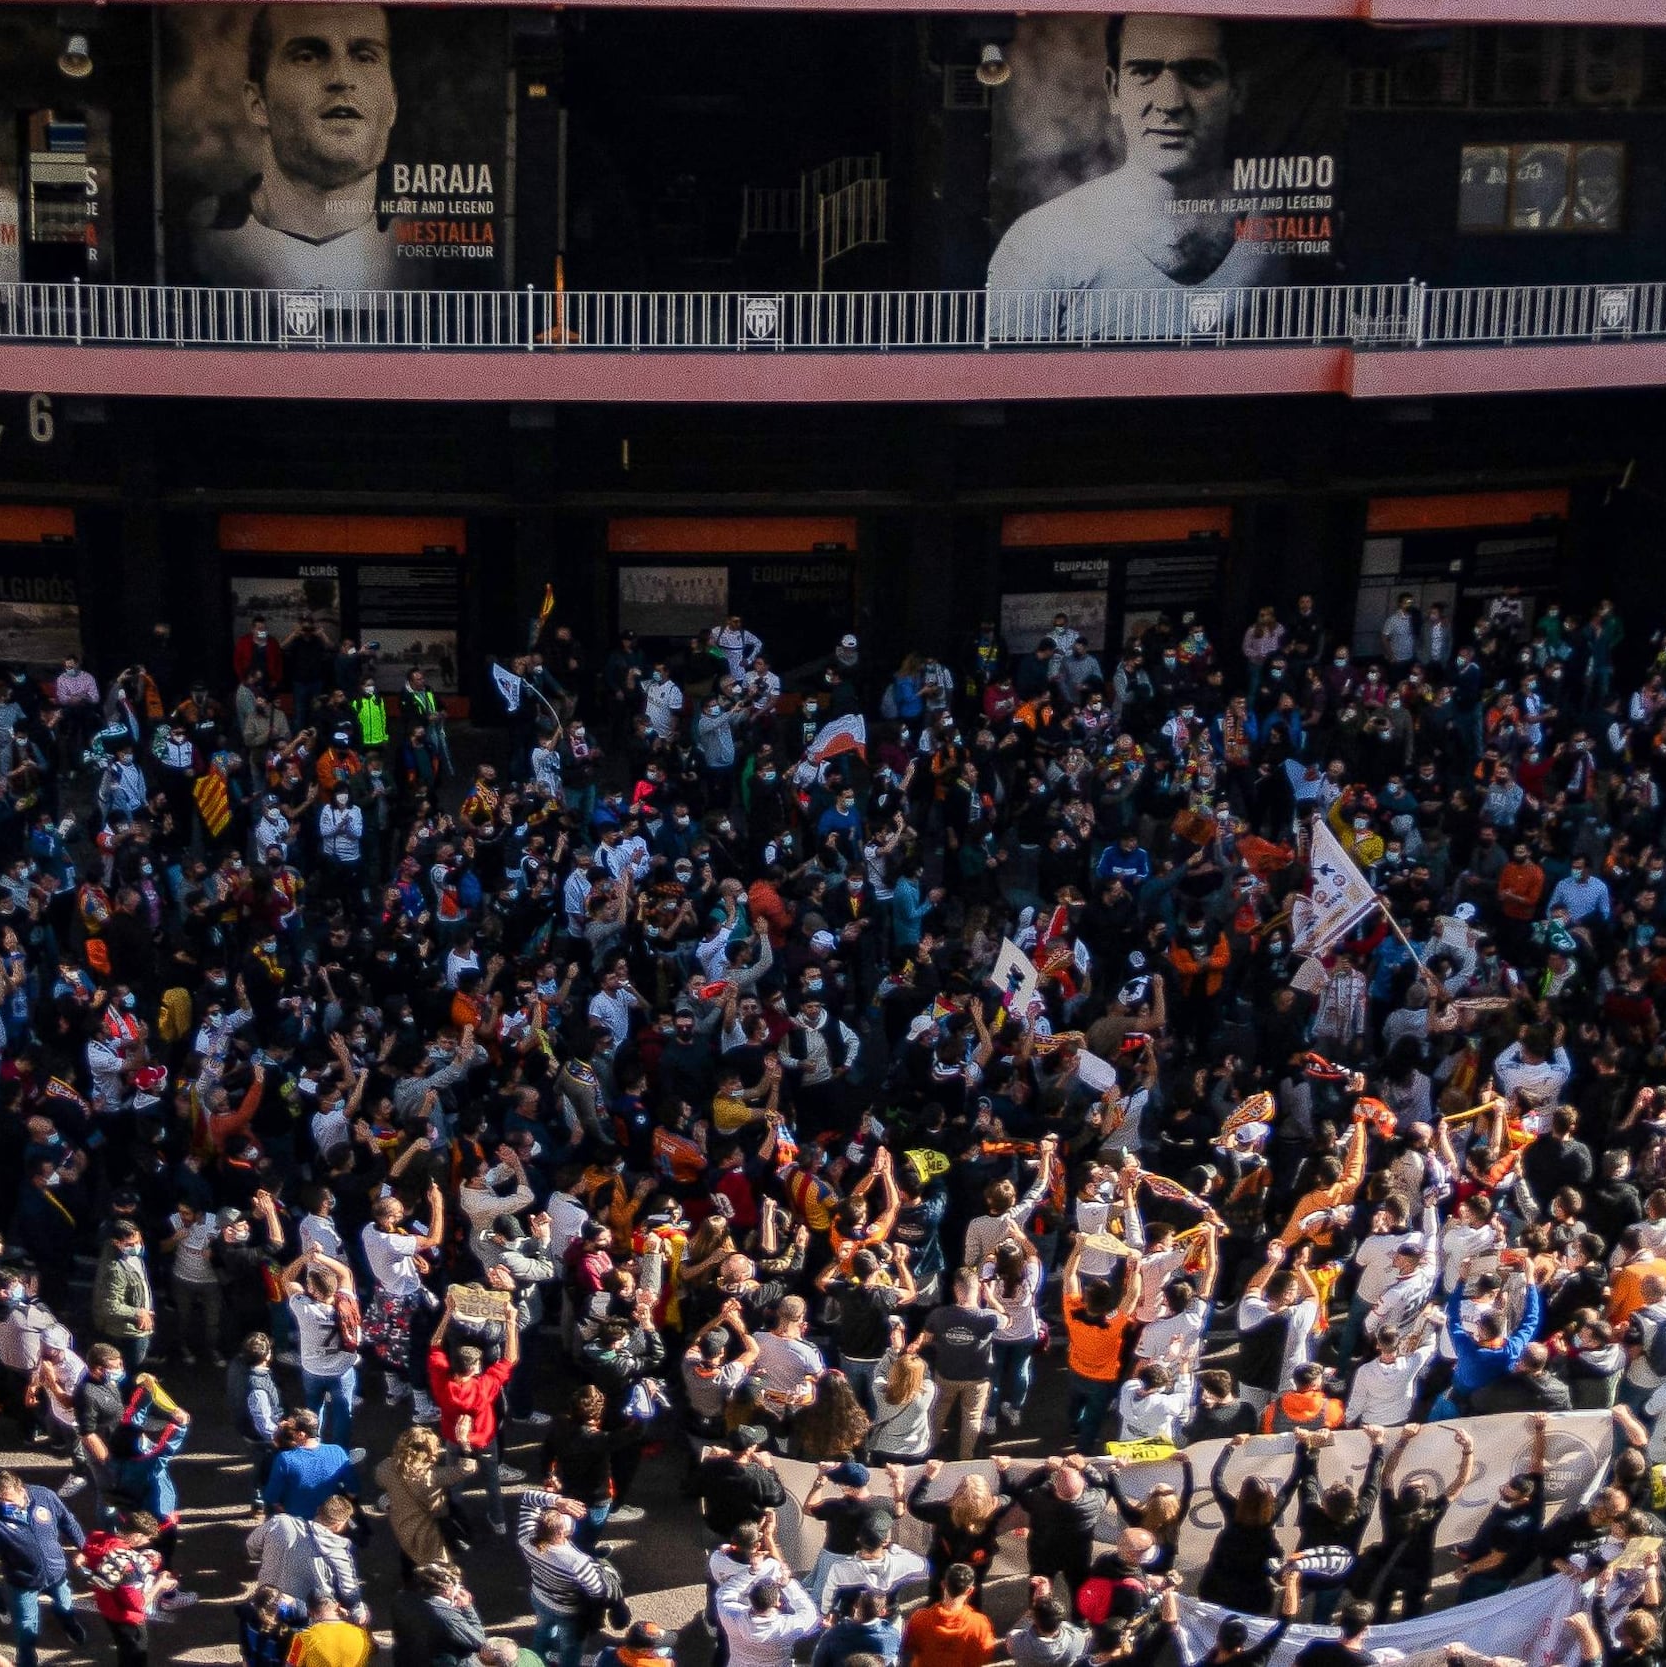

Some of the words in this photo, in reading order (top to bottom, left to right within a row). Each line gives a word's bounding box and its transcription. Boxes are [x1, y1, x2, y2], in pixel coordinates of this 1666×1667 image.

[393, 163, 494, 194] BARAJA
[1234, 155, 1334, 191] MUNDO
[381, 200, 418, 214] HEART
[421, 200, 445, 214] AND
[449, 200, 494, 214] LEGEND
[1221, 197, 1259, 213] HEART
[1260, 196, 1284, 211] AND
[1286, 195, 1332, 210] LEGEND
[395, 221, 494, 244] MESTALLA
[1234, 216, 1331, 241] MESTALLA
[29, 391, 55, 444] 6
[298, 563, 340, 578] ALGIRÓS
[1053, 558, 1111, 574] EQUIPACIÓN
